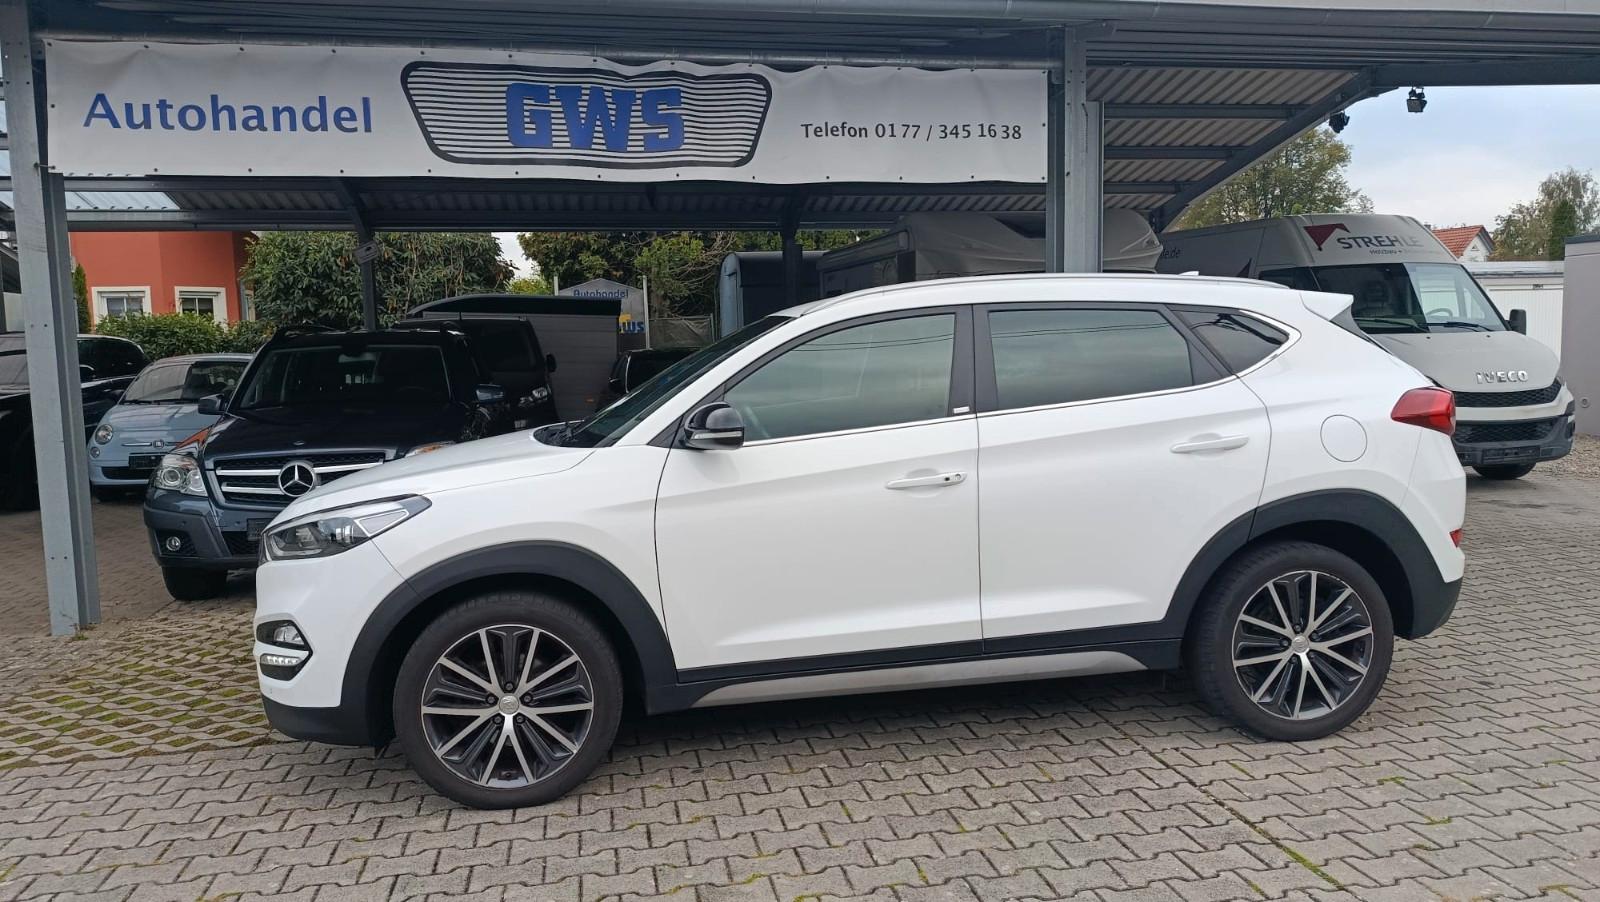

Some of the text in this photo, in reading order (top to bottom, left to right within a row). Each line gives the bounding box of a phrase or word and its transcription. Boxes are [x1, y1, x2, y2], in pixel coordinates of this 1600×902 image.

[83, 93, 372, 133] Autohandel
[505, 82, 685, 153] GWS
[800, 121, 869, 139] Telefon
[874, 122, 922, 139] 0177
[938, 123, 972, 139] 345
[1336, 235, 1424, 250] STREHLE
[573, 288, 629, 299] Autohandel
[1475, 370, 1529, 385] IVECO
